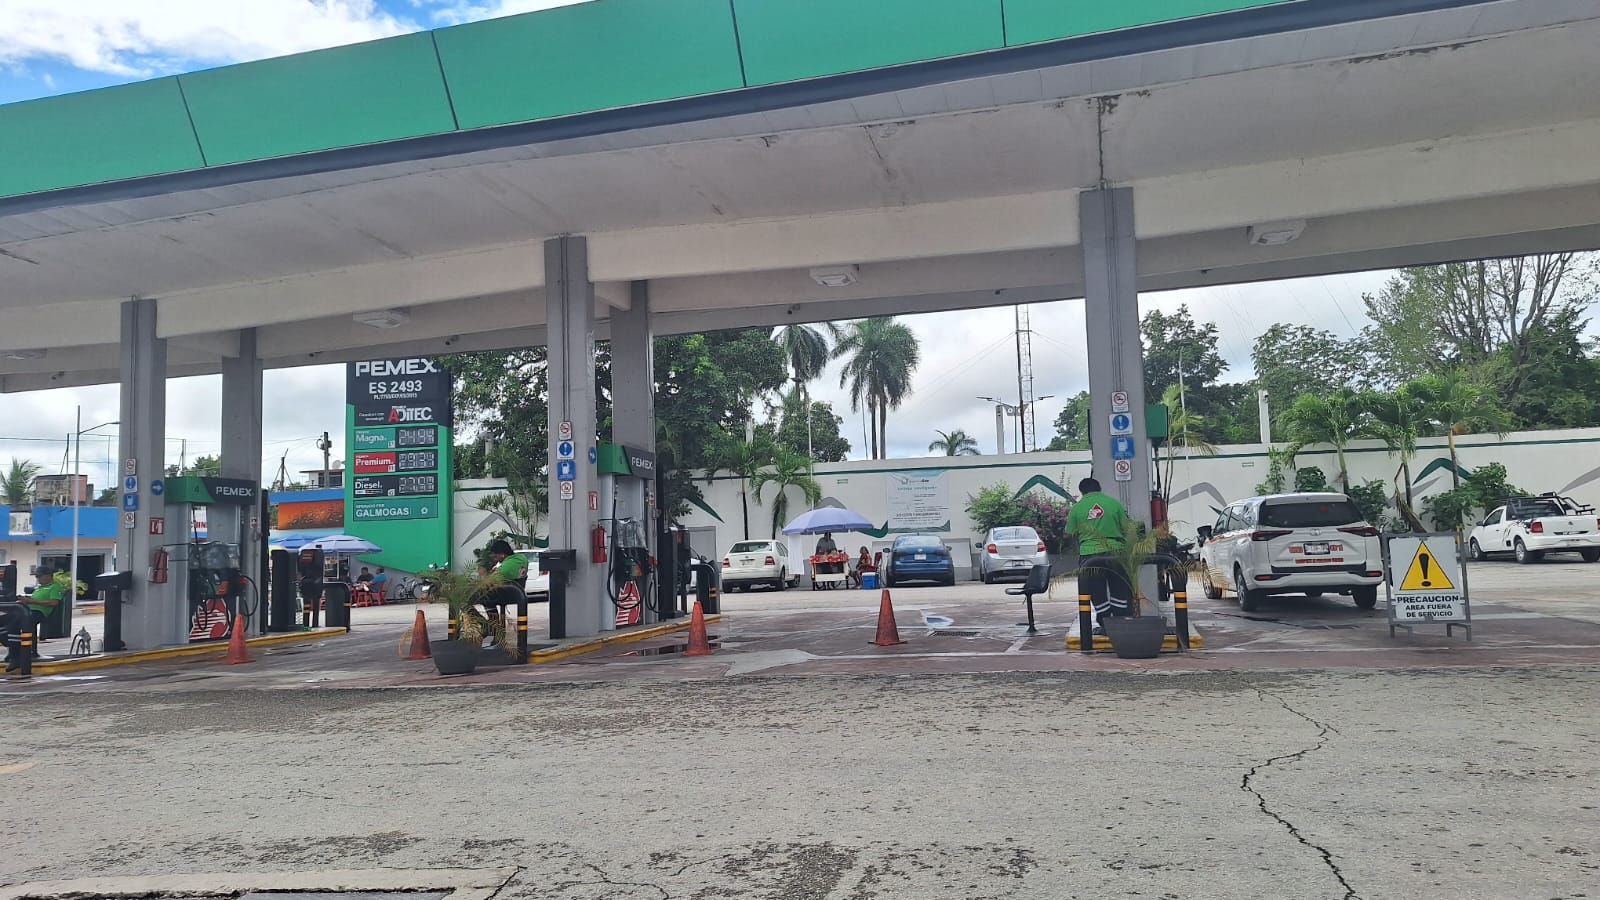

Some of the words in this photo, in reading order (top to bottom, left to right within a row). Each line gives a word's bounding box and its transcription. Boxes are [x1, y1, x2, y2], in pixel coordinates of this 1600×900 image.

[355, 358, 438, 377] PEMEX
[368, 382, 387, 394] ES
[390, 379, 423, 393] 2493
[355, 434, 384, 444] Magna
[355, 457, 391, 467] Premium
[631, 457, 653, 470] PEMEX
[355, 480, 380, 489] Diesel
[216, 486, 252, 496] PEMEX
[355, 507, 409, 517] GALMOGAS
[1397, 595, 1459, 604] PRECAUCION
